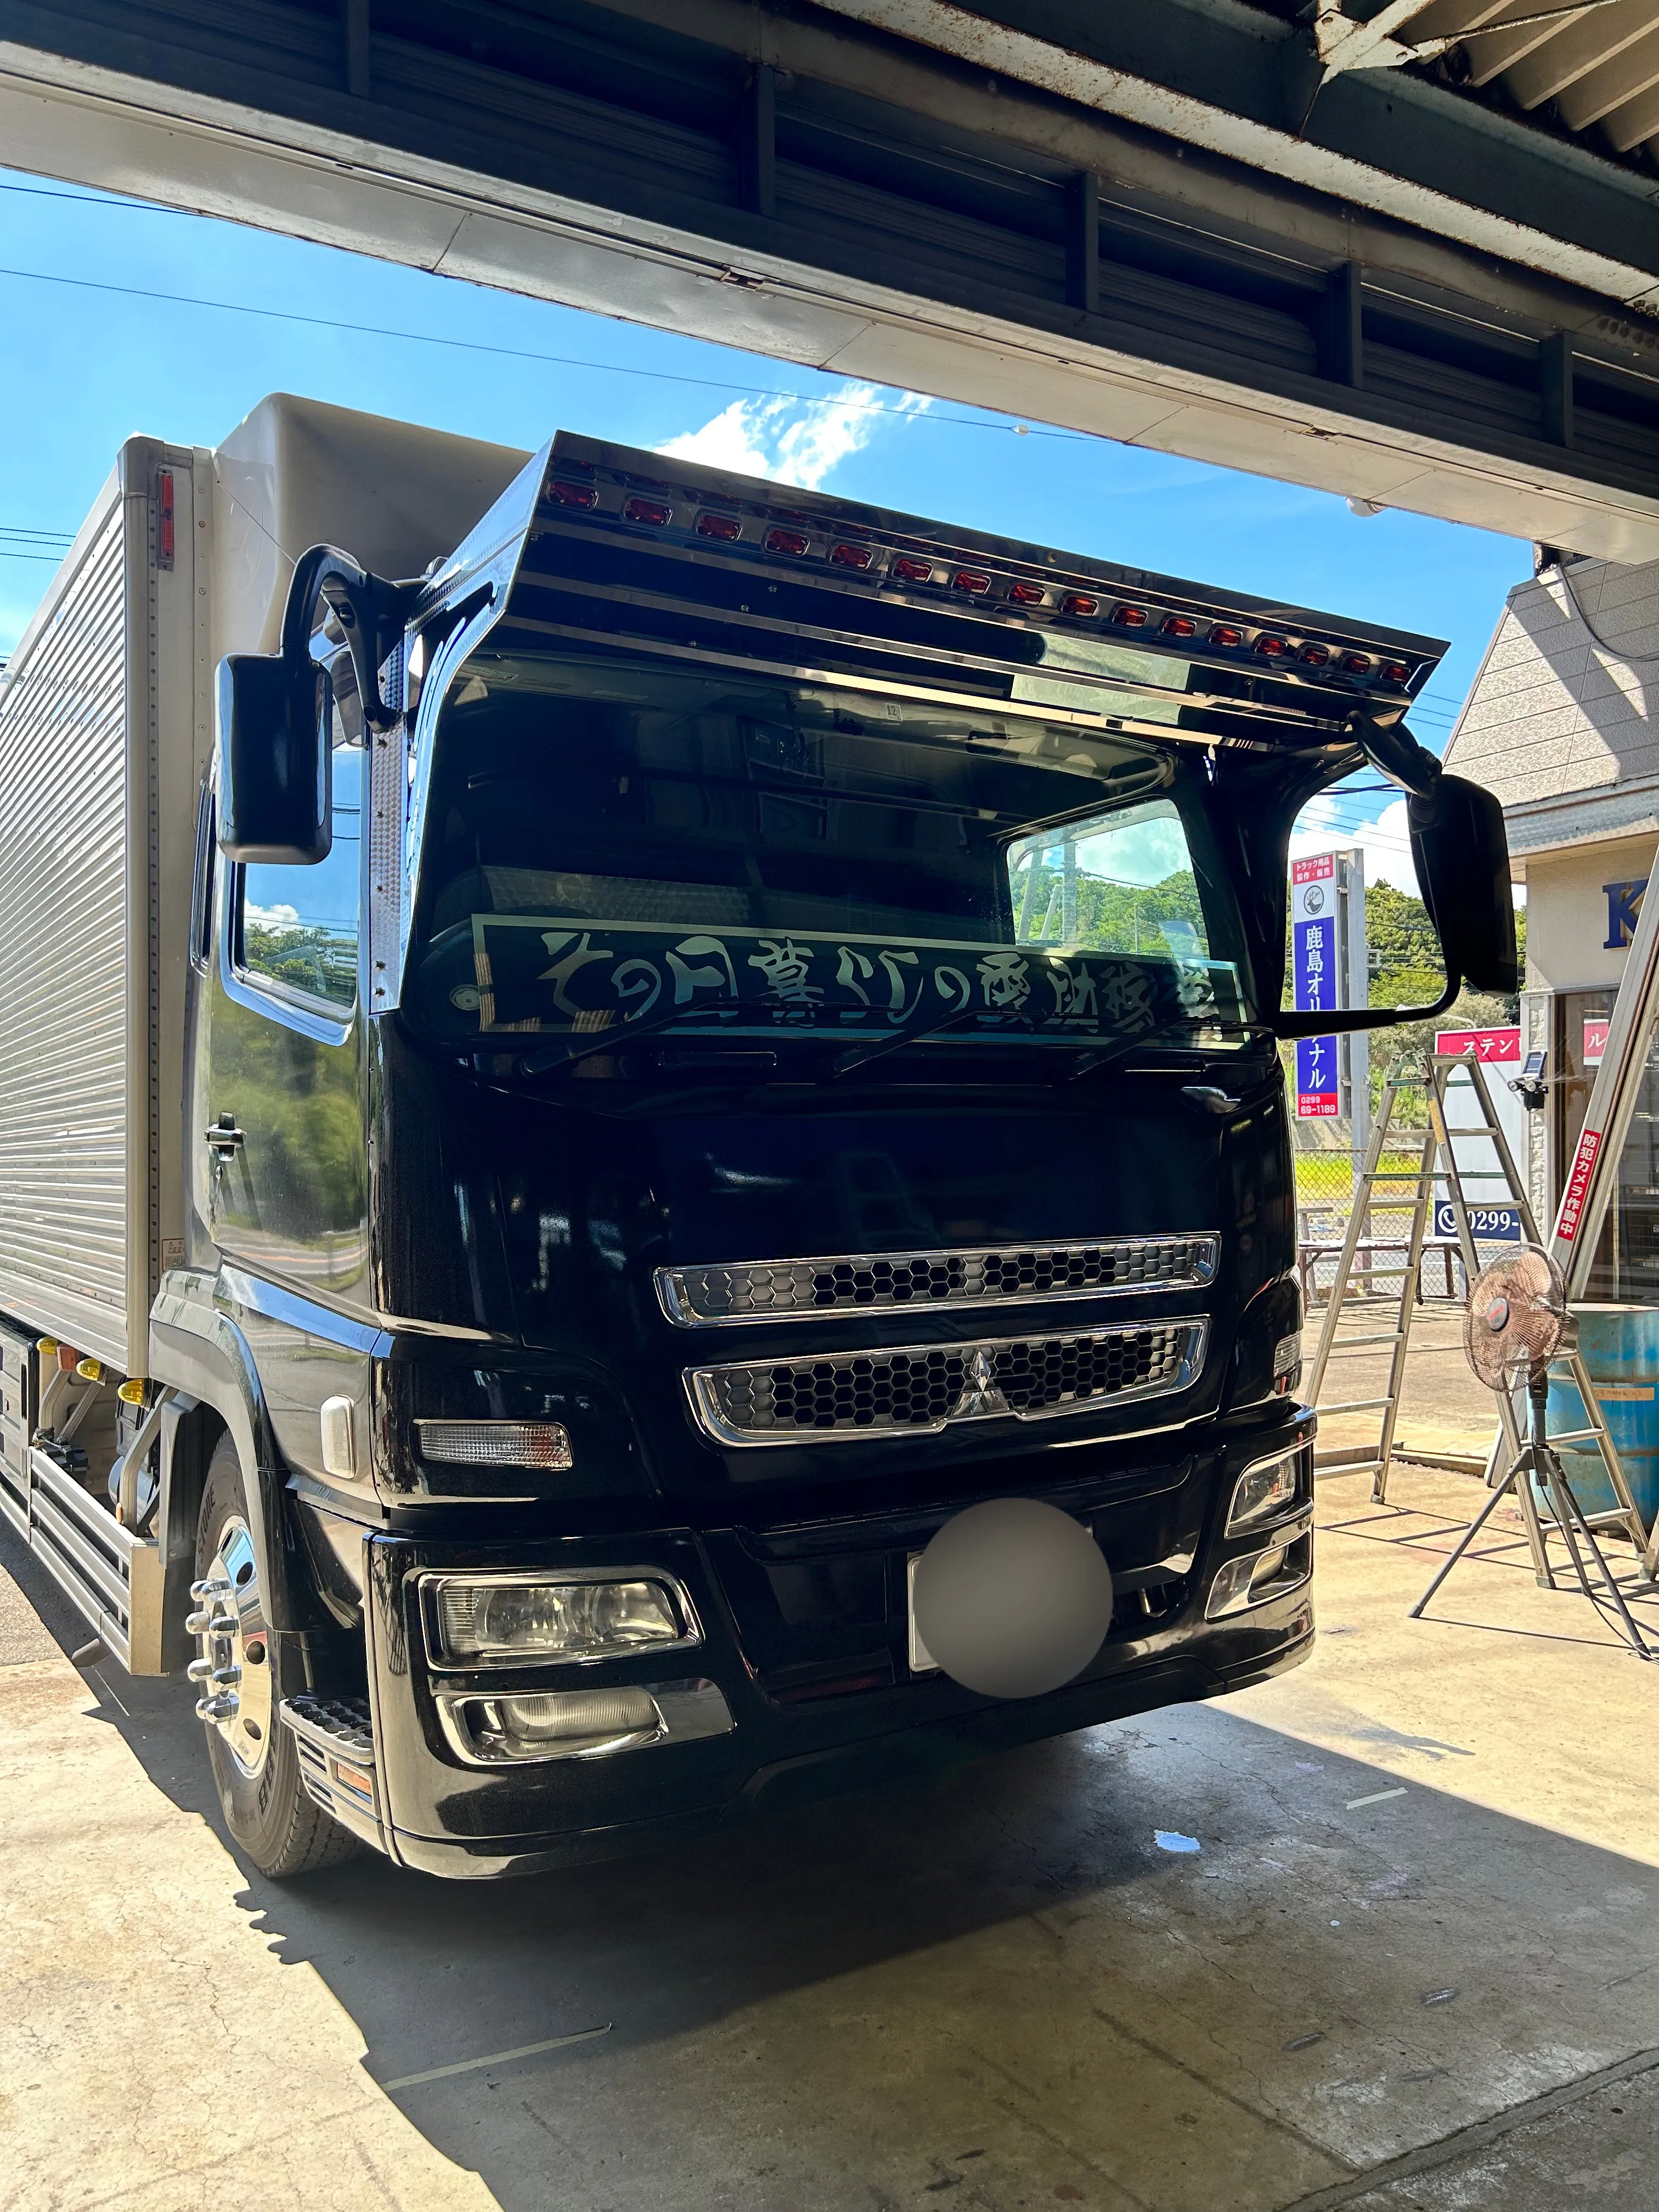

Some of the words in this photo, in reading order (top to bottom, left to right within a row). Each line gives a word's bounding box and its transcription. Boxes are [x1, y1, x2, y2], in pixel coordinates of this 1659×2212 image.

[1296, 857, 1330, 872] トラック用品
[1296, 867, 1330, 882] 製作・販売
[1602, 879, 1649, 950] K
[1306, 925, 1326, 1089] 鹿島オリナル
[1463, 1036, 1521, 1057] ステン
[1301, 1096, 1321, 1104] 0299
[1300, 1104, 1336, 1115] 69-1189
[1560, 1133, 1598, 1234] 防犯カメラ作動中
